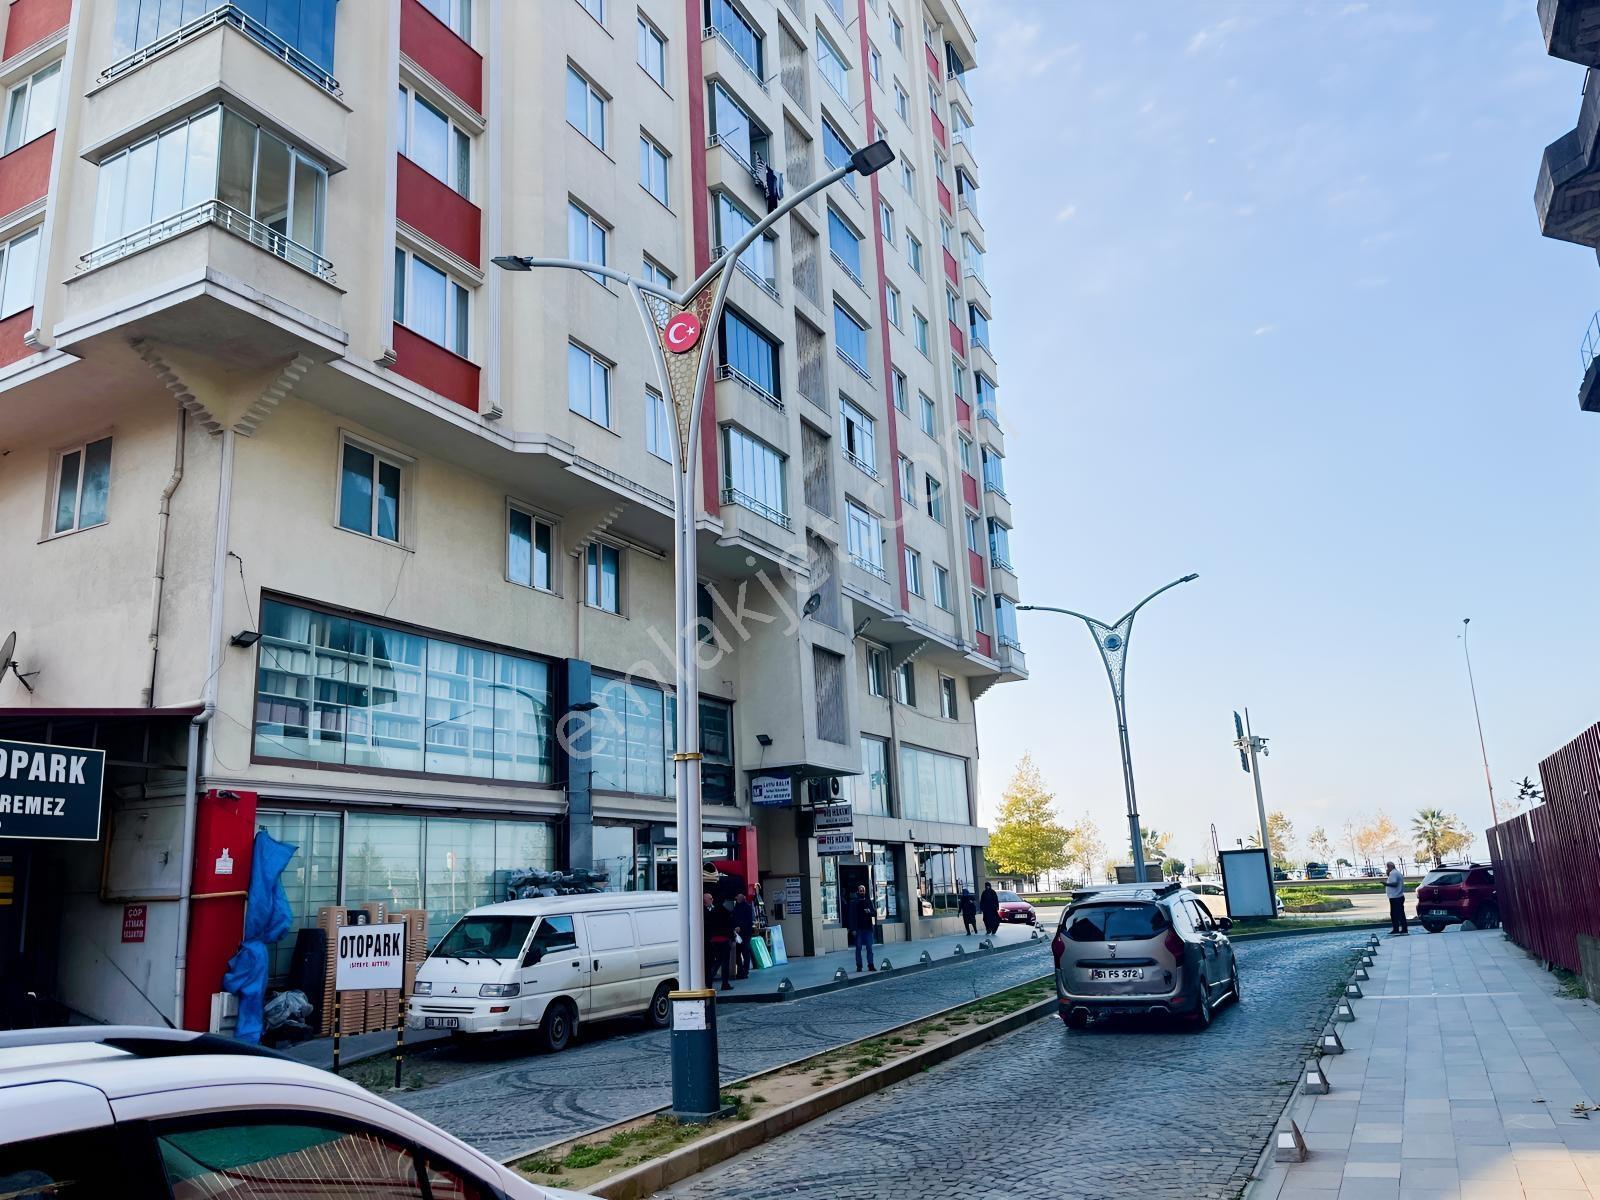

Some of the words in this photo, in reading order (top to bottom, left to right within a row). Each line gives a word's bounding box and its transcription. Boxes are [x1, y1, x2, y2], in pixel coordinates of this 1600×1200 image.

[340, 933, 401, 959] OTOPARK
[1109, 970, 1120, 979] FS
[1122, 969, 1138, 978] 372
